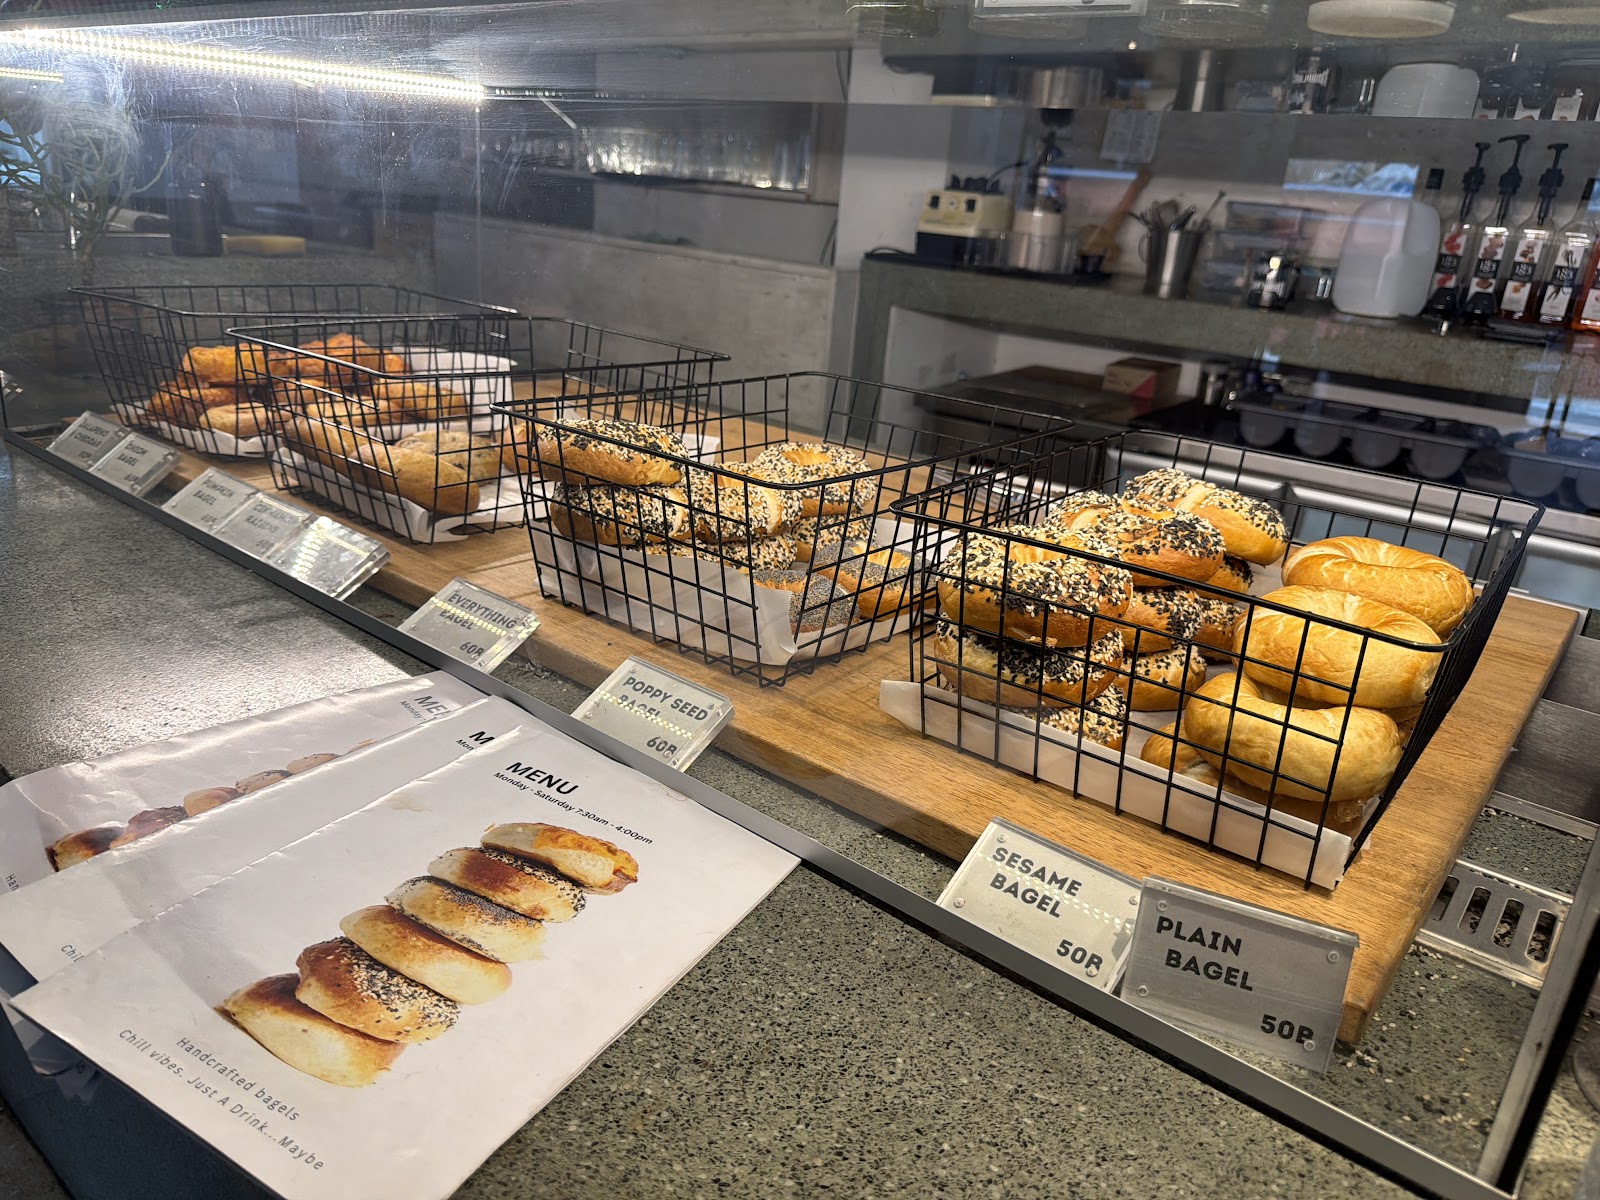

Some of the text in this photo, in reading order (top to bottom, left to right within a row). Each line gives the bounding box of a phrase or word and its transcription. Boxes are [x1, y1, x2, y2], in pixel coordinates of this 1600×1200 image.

[448, 593, 517, 628] EVERYTHING
[623, 677, 708, 721] POPPY SEED
[506, 762, 580, 795] MENU
[493, 772, 529, 791] Monday
[534, 790, 576, 812] Saturday
[574, 807, 609, 826] 7:30am
[615, 824, 653, 845] 4:00pm
[992, 847, 1082, 897] SESAME
[990, 873, 1061, 918] BAGEL
[1156, 915, 1242, 957] PLAIN
[1165, 948, 1253, 991] BAGEL
[119, 1029, 152, 1052] Chill
[150, 1050, 184, 1077] vibes.
[187, 1076, 218, 1098] Just
[217, 1096, 231, 1106] A
[176, 1037, 300, 1121] Handcrafted bagels
